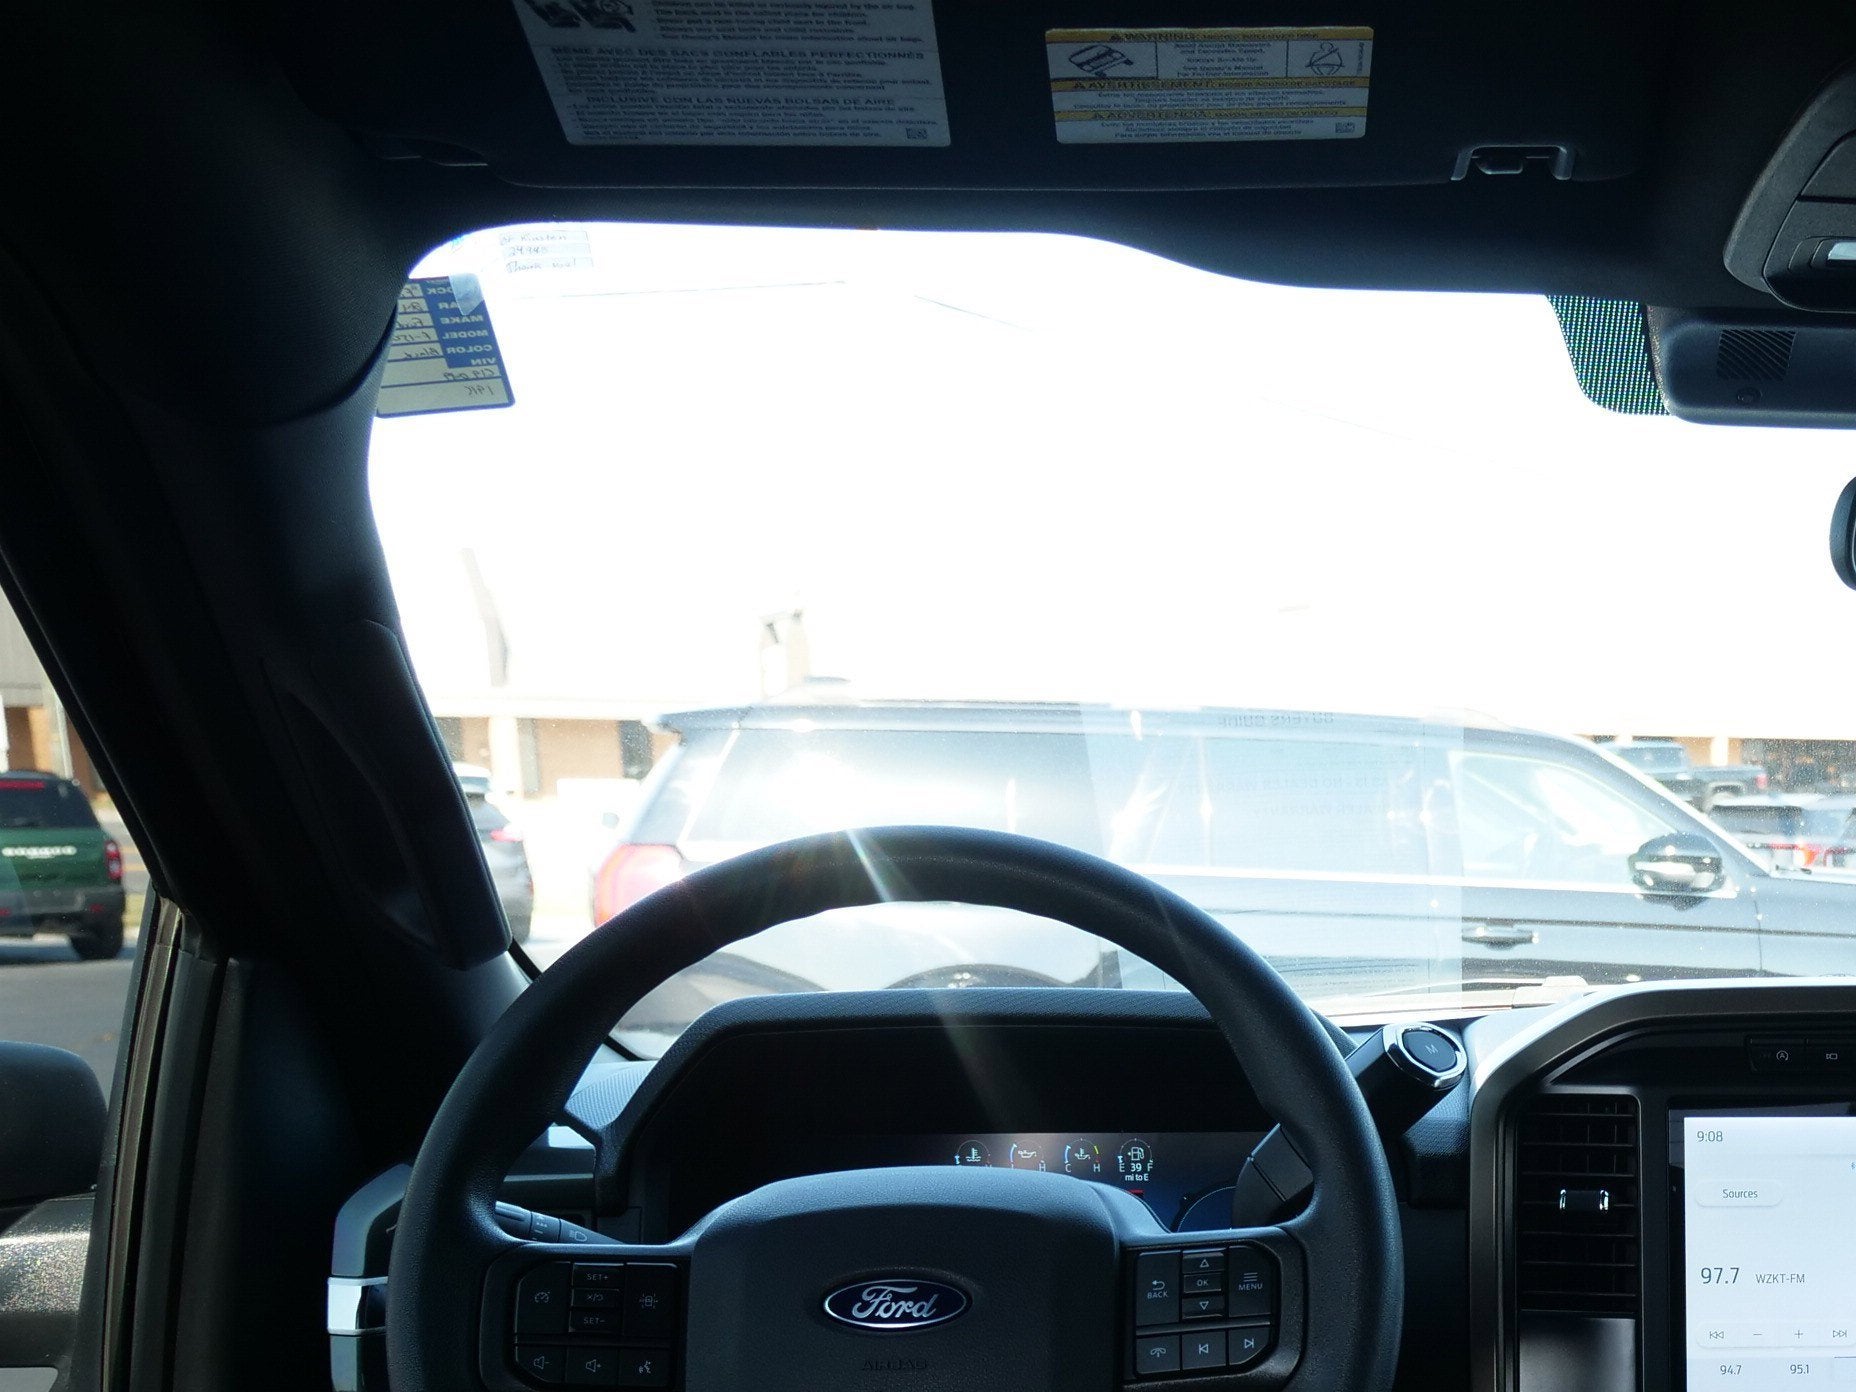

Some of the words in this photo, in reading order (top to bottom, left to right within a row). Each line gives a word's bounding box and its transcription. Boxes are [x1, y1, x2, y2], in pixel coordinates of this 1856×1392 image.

[1425, 1045, 1439, 1055] M
[1696, 1130, 1724, 1142] 9:08
[1065, 1163, 1072, 1173] C
[1093, 1163, 1101, 1173] H
[1119, 1163, 1126, 1173] E
[1130, 1162, 1142, 1172] 39
[1147, 1162, 1153, 1172] F
[1124, 1173, 1134, 1181] mi
[1135, 1173, 1143, 1181] to
[1143, 1173, 1149, 1181] E
[1722, 1188, 1758, 1200] Sources
[586, 1272, 609, 1281] SET+
[1700, 1266, 1740, 1285] 97.7
[1755, 1273, 1805, 1284] WZKT-FM
[1196, 1279, 1209, 1287] OK
[1238, 1282, 1263, 1291] MENU
[1147, 1290, 1169, 1299] BACK
[851, 1283, 937, 1320] Ford
[1720, 1364, 1742, 1375] 94.7
[1790, 1363, 1810, 1374] 95.1
